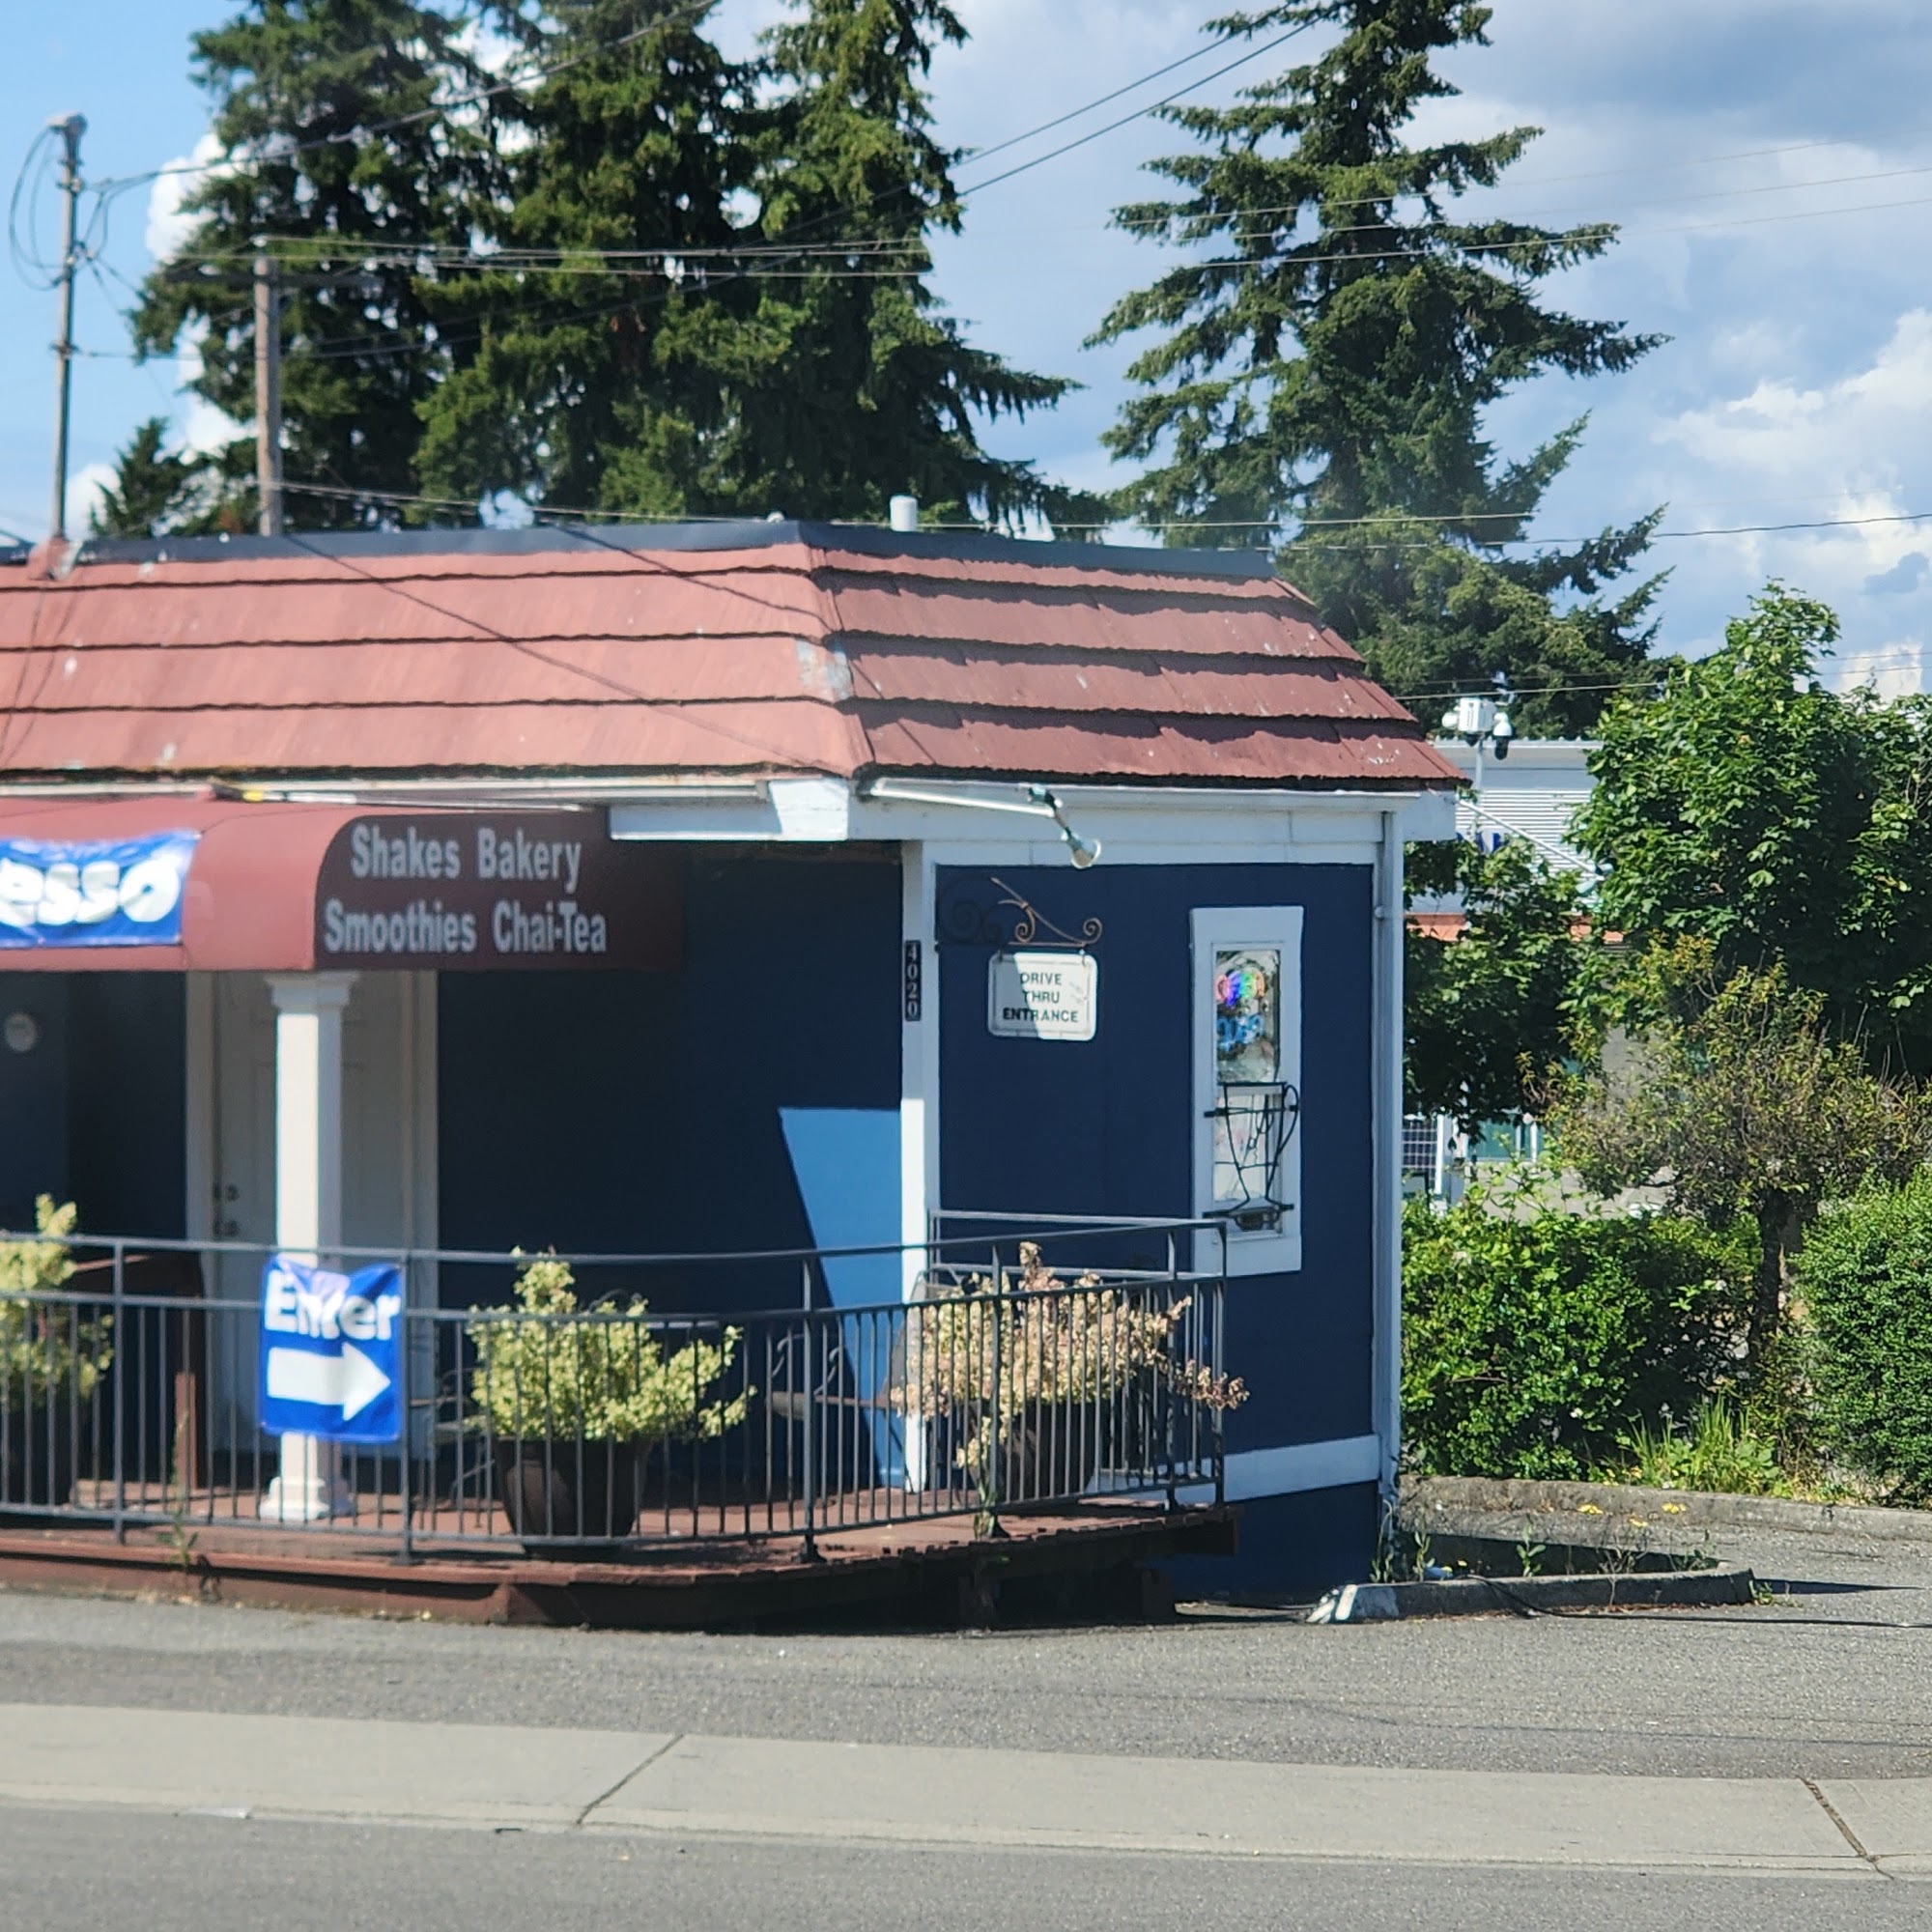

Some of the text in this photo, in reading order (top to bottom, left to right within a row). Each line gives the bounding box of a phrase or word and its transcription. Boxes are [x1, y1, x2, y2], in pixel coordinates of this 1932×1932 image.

[350, 823, 582, 895] Shakes Bakery
[323, 897, 608, 953] Smoothies Chai-Tea
[906, 942, 919, 1018] 4020
[1020, 972, 1063, 985] DRIVE
[1022, 990, 1061, 1004] THRU
[1002, 1008, 1079, 1023] ENTRANCE
[264, 1269, 402, 1341] Enter
